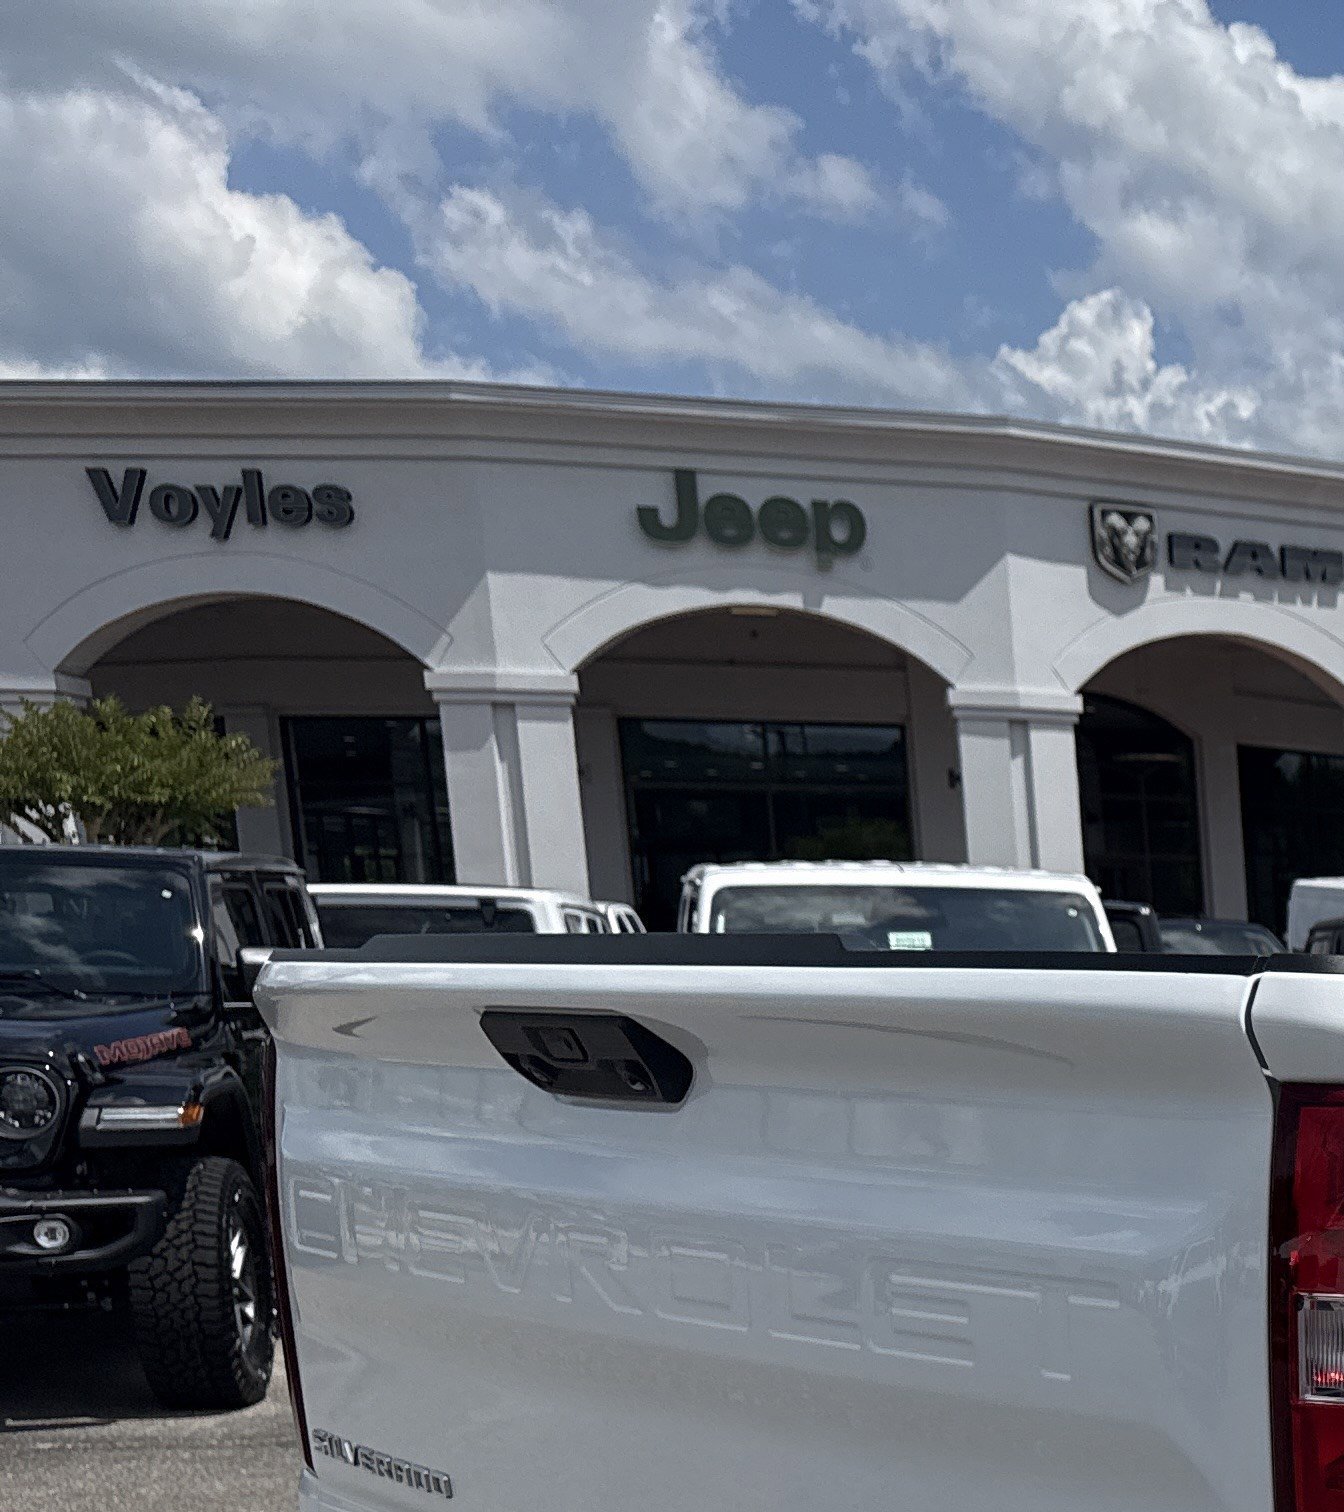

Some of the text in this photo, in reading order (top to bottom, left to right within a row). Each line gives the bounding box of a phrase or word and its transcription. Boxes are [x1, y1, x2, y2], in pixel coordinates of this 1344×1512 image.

[85, 466, 355, 540] Voyles
[636, 470, 867, 573] Jeep
[1167, 532, 1344, 586] RAM
[94, 1027, 192, 1066] MOJAVE
[286, 1174, 1122, 1382] CHEVROLET
[312, 1428, 454, 1500] SILVERADO
